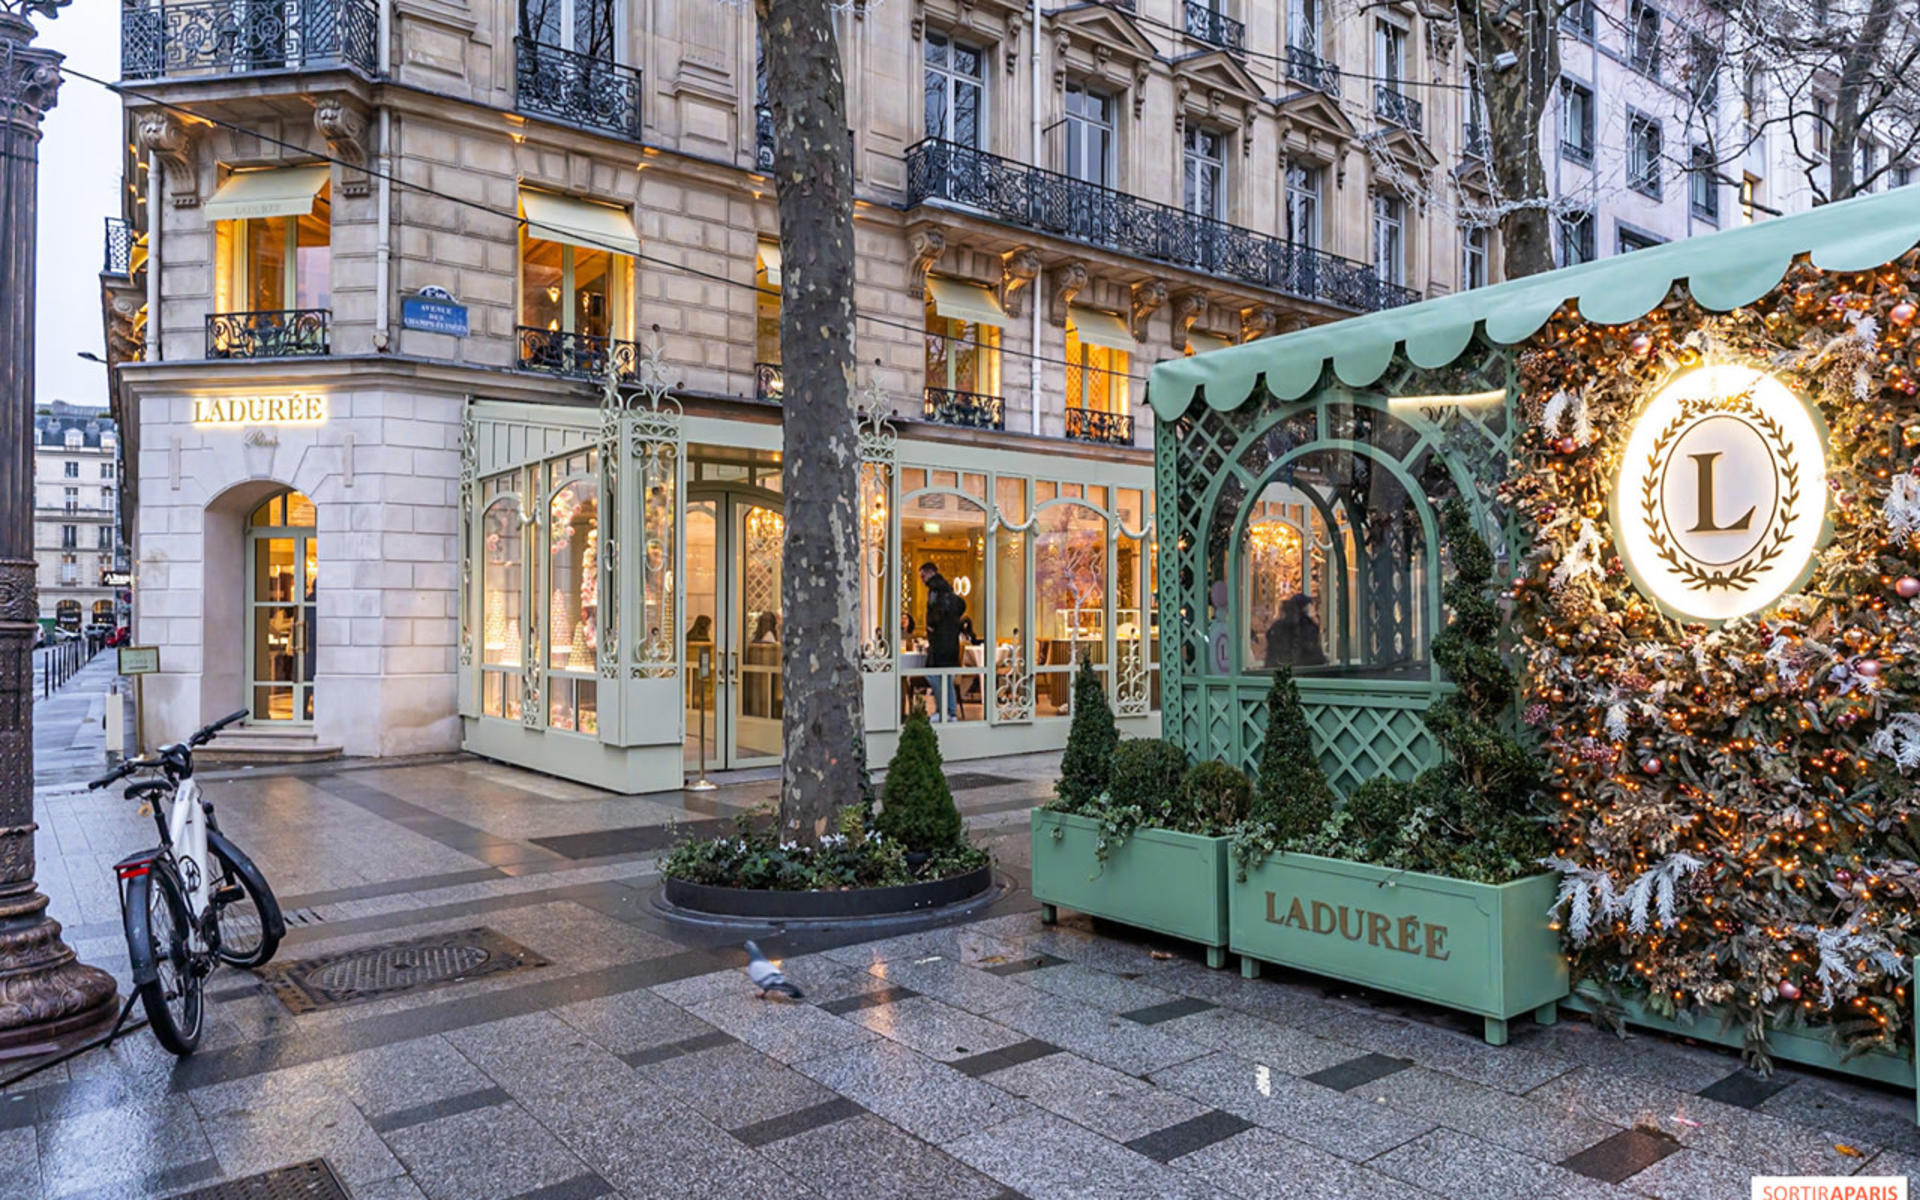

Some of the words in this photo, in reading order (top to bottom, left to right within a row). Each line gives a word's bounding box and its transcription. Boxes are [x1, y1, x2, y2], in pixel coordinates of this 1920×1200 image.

[421, 304, 451, 315] AVENUE
[429, 313, 444, 321] DES
[193, 393, 323, 422] LADURÉE
[1685, 451, 1757, 533] L
[1265, 890, 1451, 961] LADURÉE
